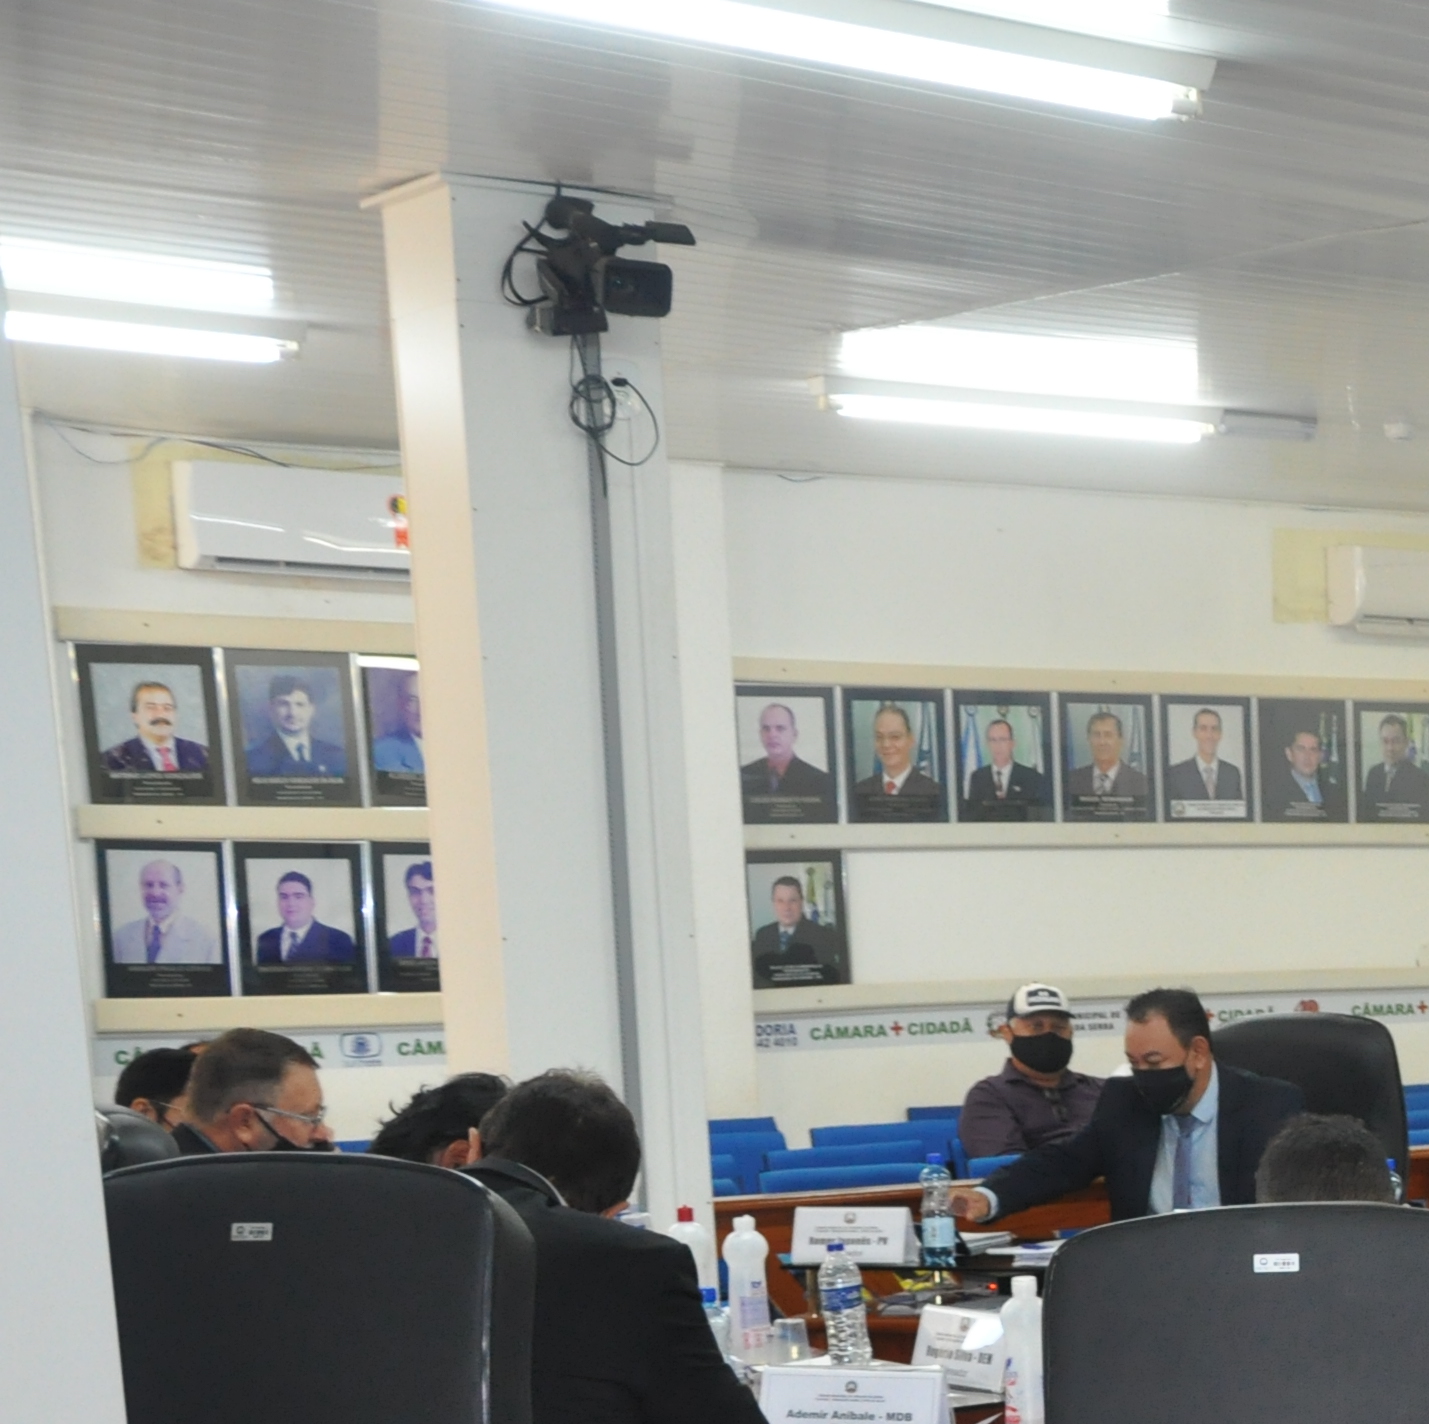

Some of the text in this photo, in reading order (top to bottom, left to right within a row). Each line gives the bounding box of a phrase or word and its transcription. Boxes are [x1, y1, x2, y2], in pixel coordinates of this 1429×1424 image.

[1352, 998, 1415, 1016] CÂMARA
[810, 1017, 973, 1041] CÂMARA CIDADÃ
[397, 1040, 446, 1057] CÂM
[786, 1409, 828, 1420] Ademir
[886, 1412, 913, 1422] MDB
